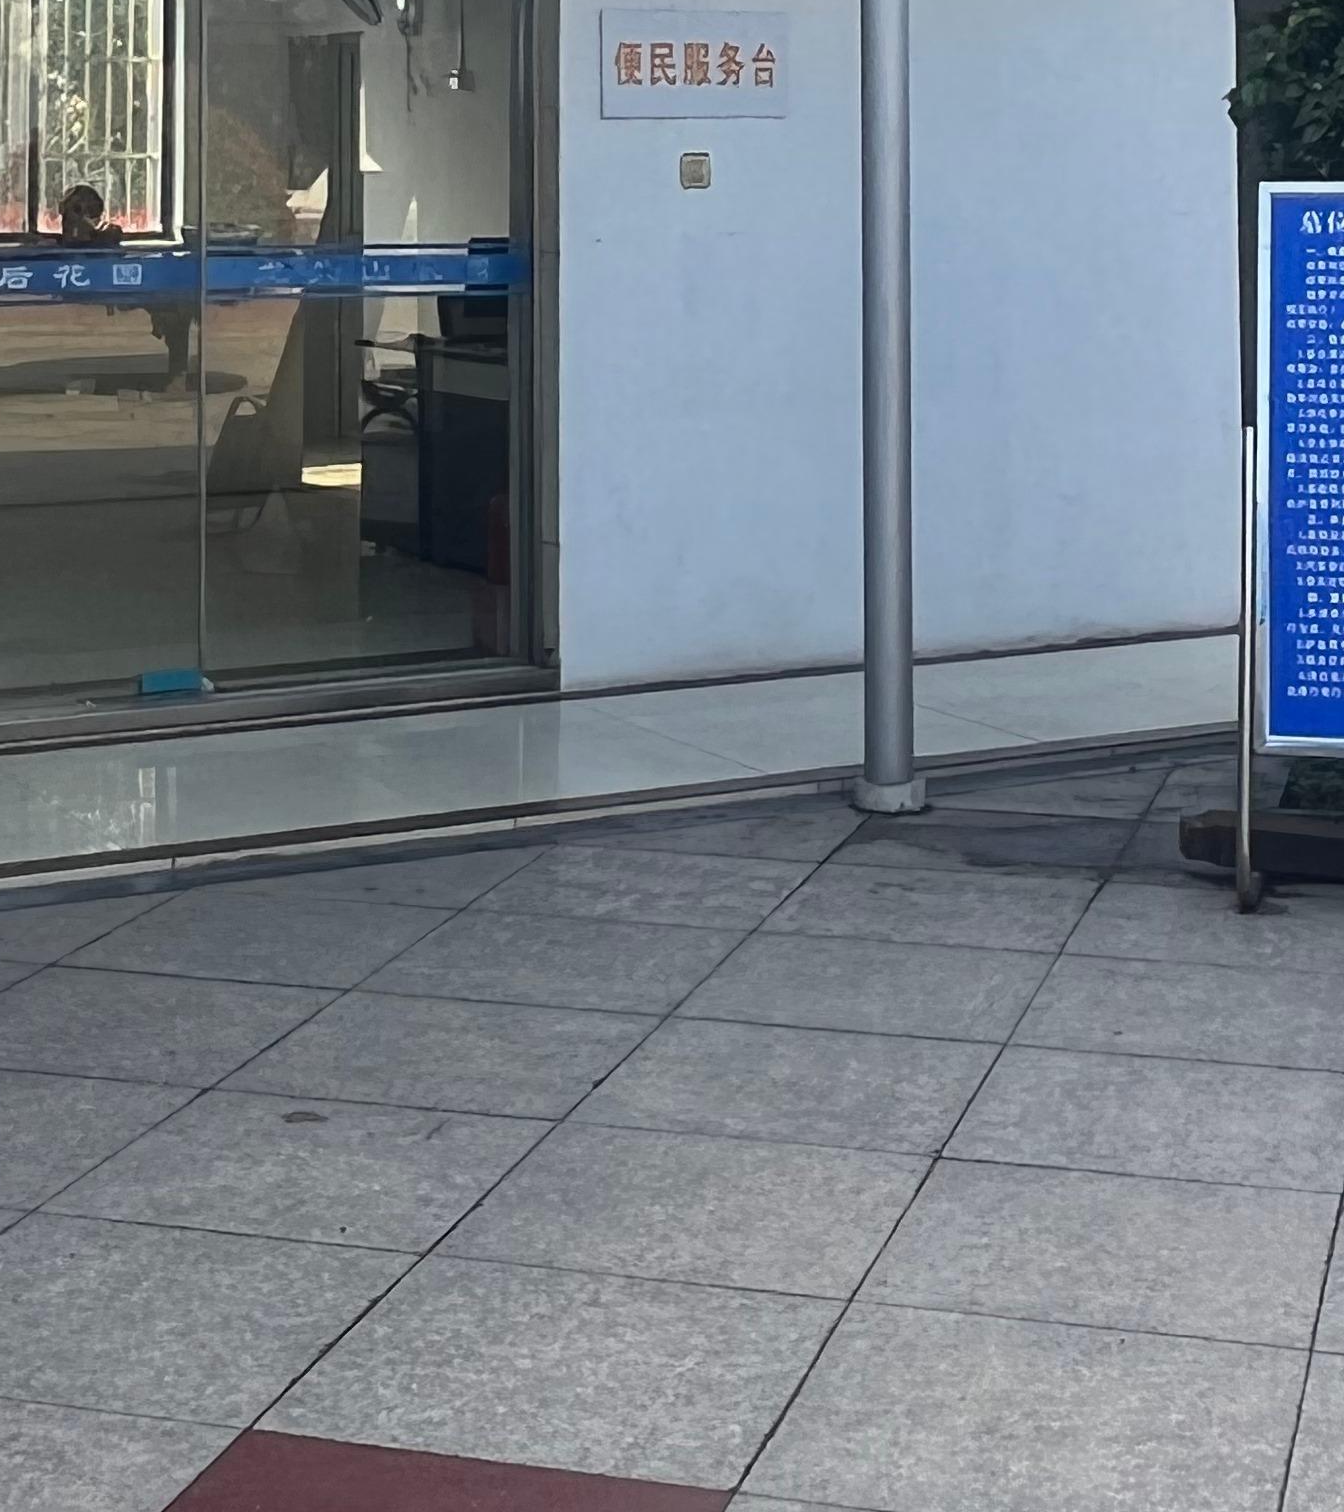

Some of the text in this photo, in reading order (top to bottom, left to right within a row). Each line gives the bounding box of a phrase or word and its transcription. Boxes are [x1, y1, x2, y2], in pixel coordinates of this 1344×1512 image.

[614, 41, 776, 88] 便民服务台
